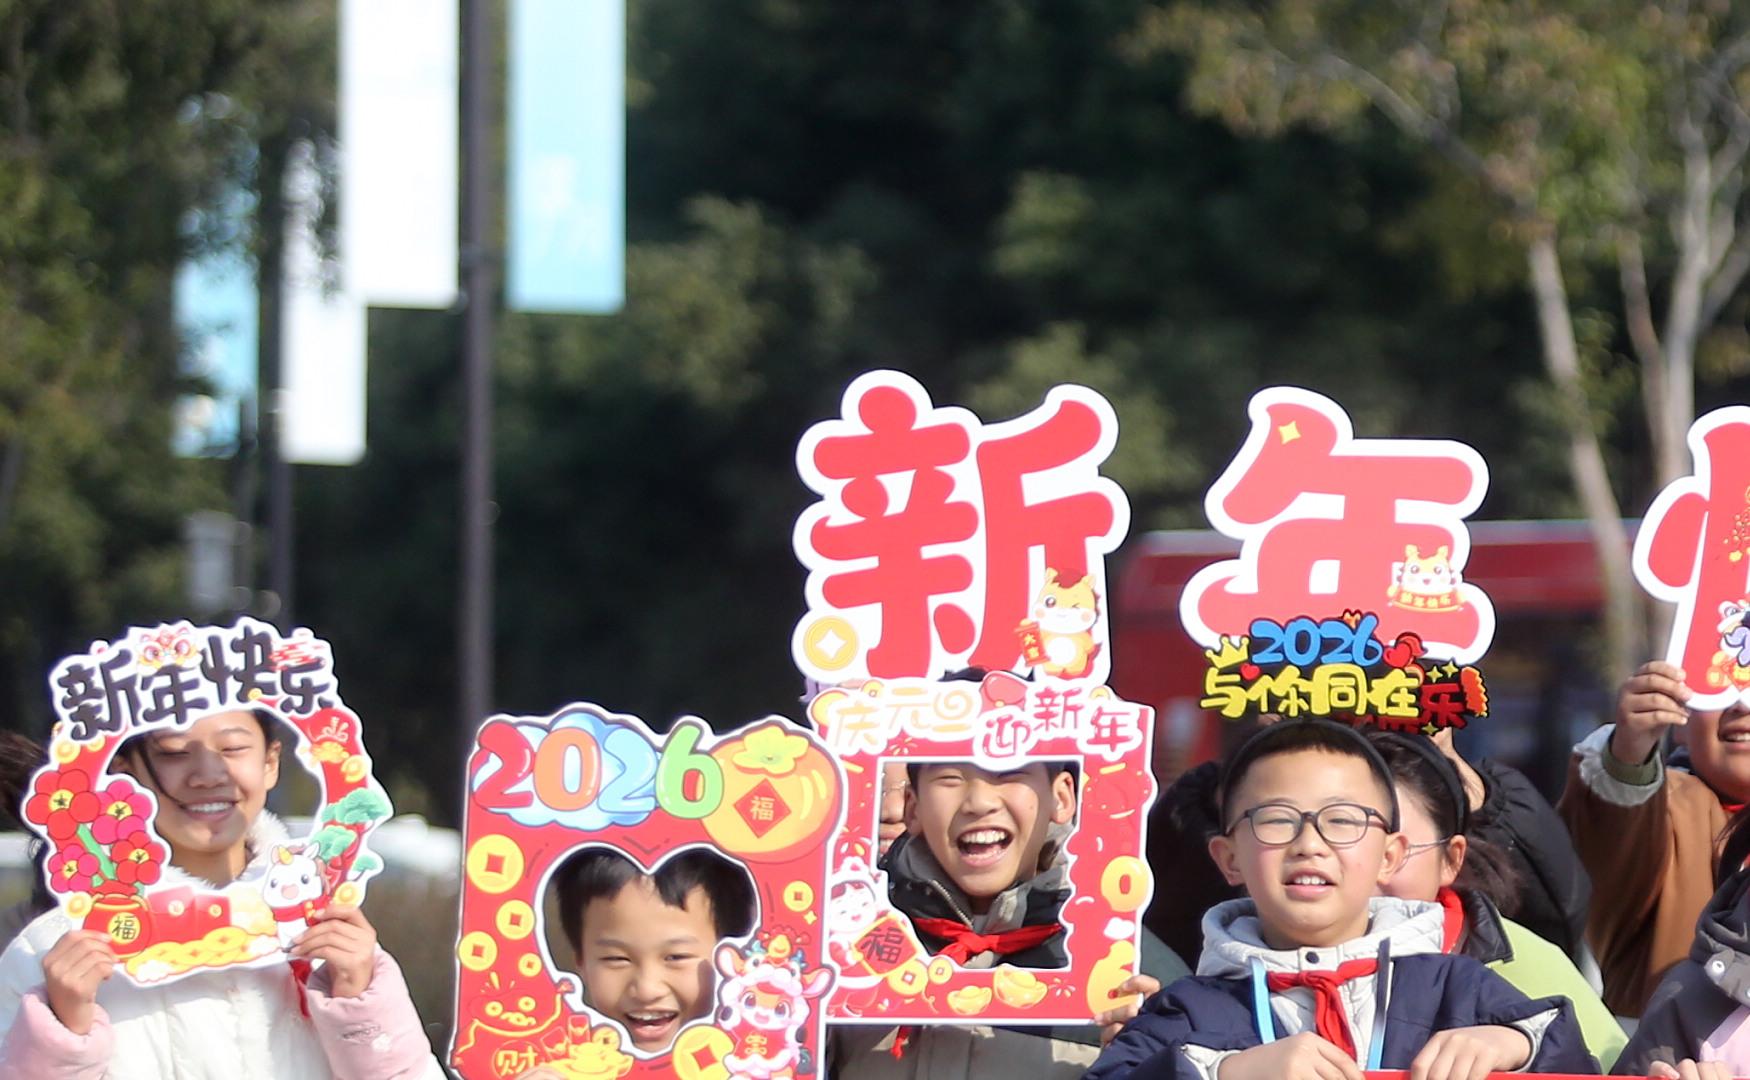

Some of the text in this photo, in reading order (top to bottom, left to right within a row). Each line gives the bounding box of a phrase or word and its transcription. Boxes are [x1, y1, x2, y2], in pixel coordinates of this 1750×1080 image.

[811, 385, 1114, 679] 新
[1197, 402, 1473, 648] 年
[1250, 614, 1383, 667] 2026
[58, 625, 333, 741] 新年快乐
[1200, 663, 1420, 719] 与你同在
[834, 686, 1133, 758] 庆元旦迎新年
[473, 721, 724, 821] 2026
[750, 794, 775, 823] 福
[112, 914, 141, 943] 福
[860, 926, 905, 965] 福
[497, 1045, 538, 1076] 财
